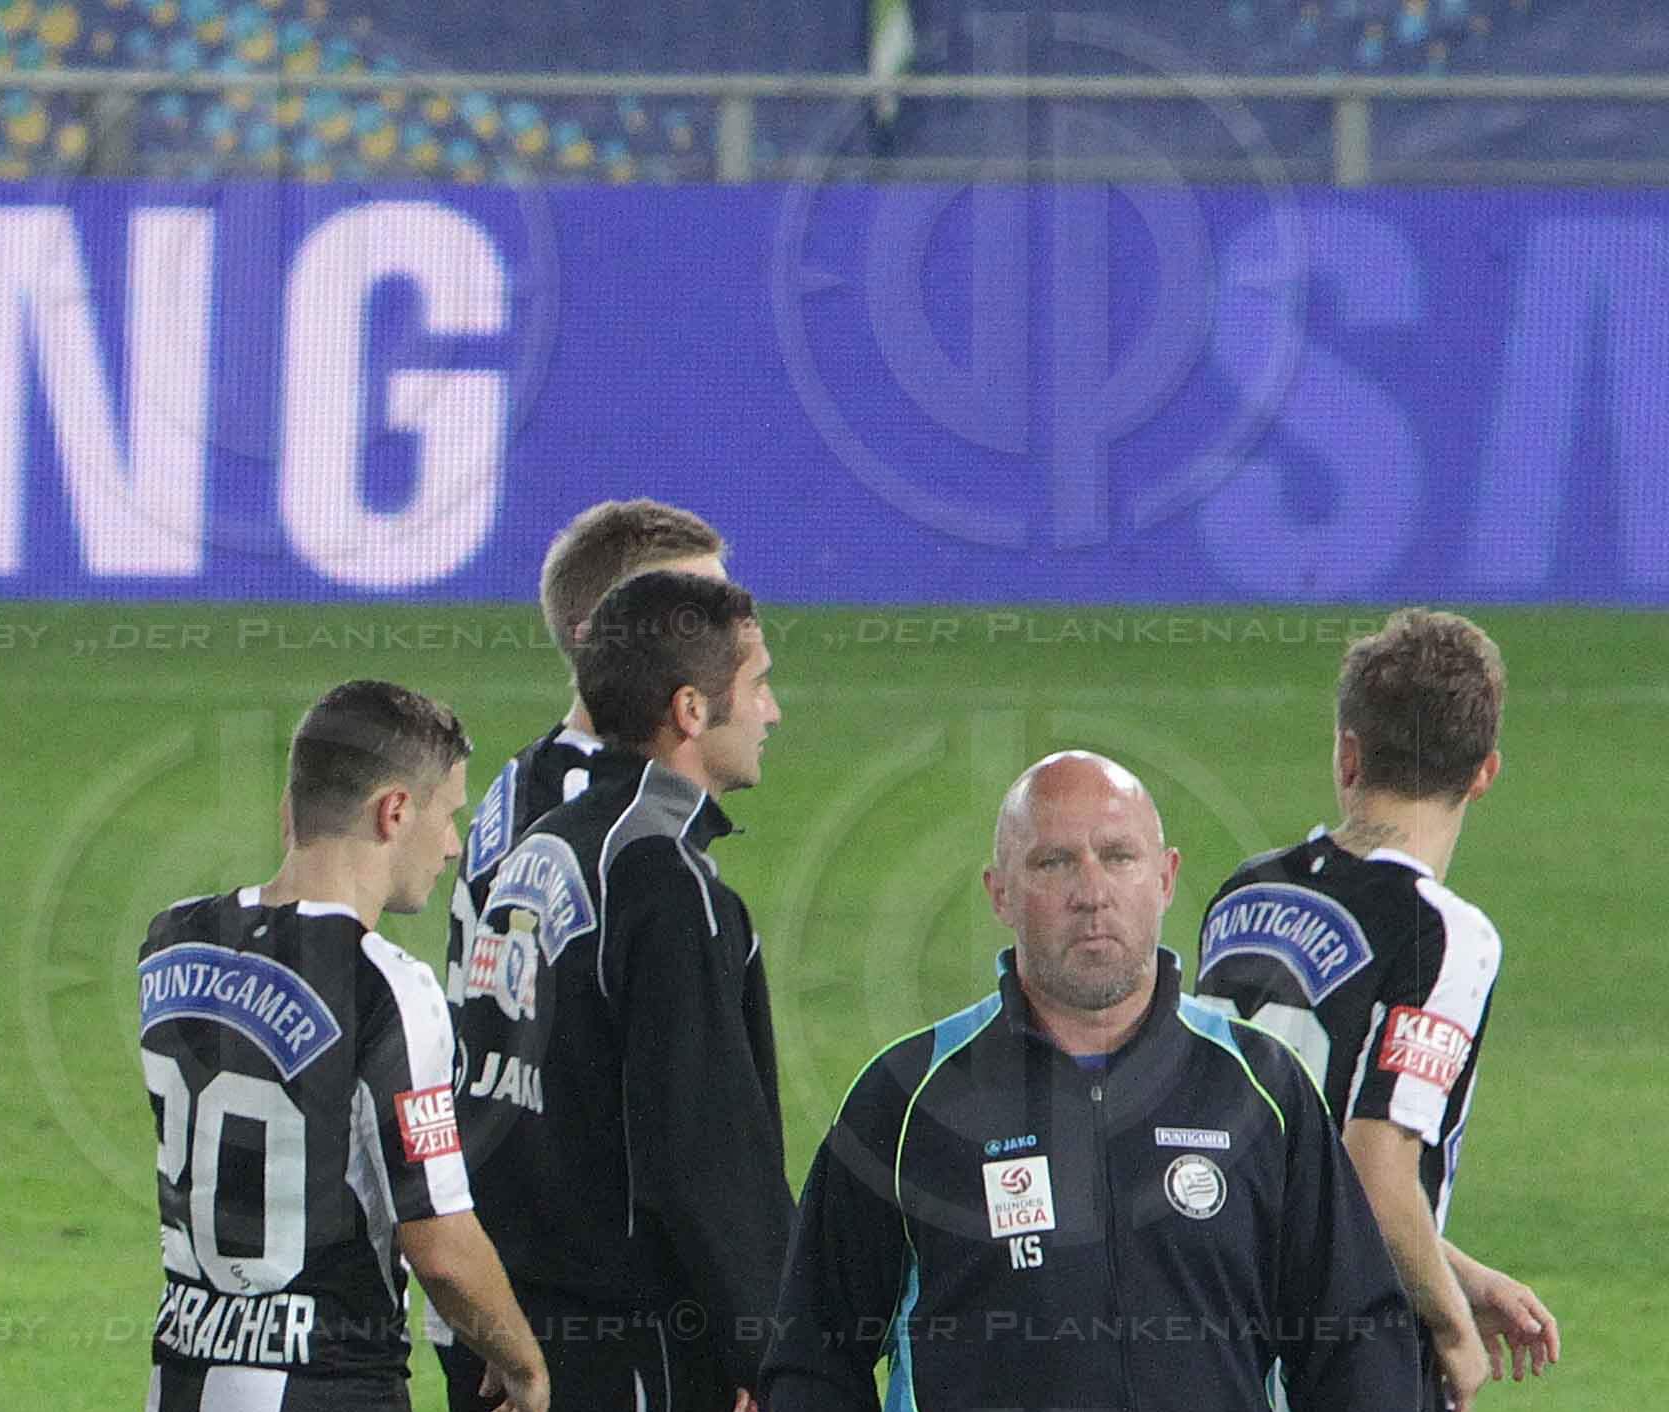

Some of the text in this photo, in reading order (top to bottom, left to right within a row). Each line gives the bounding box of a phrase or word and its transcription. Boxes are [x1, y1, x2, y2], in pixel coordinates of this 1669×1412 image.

[1209, 901, 1348, 979] PUNTIGAMER
[141, 962, 317, 1056] PUNTIGAMER
[1003, 1134, 1037, 1151] JAKO
[995, 1200, 1045, 1214] BUNDES
[996, 1206, 1048, 1230] LIGA
[1009, 1234, 1044, 1270] KS
